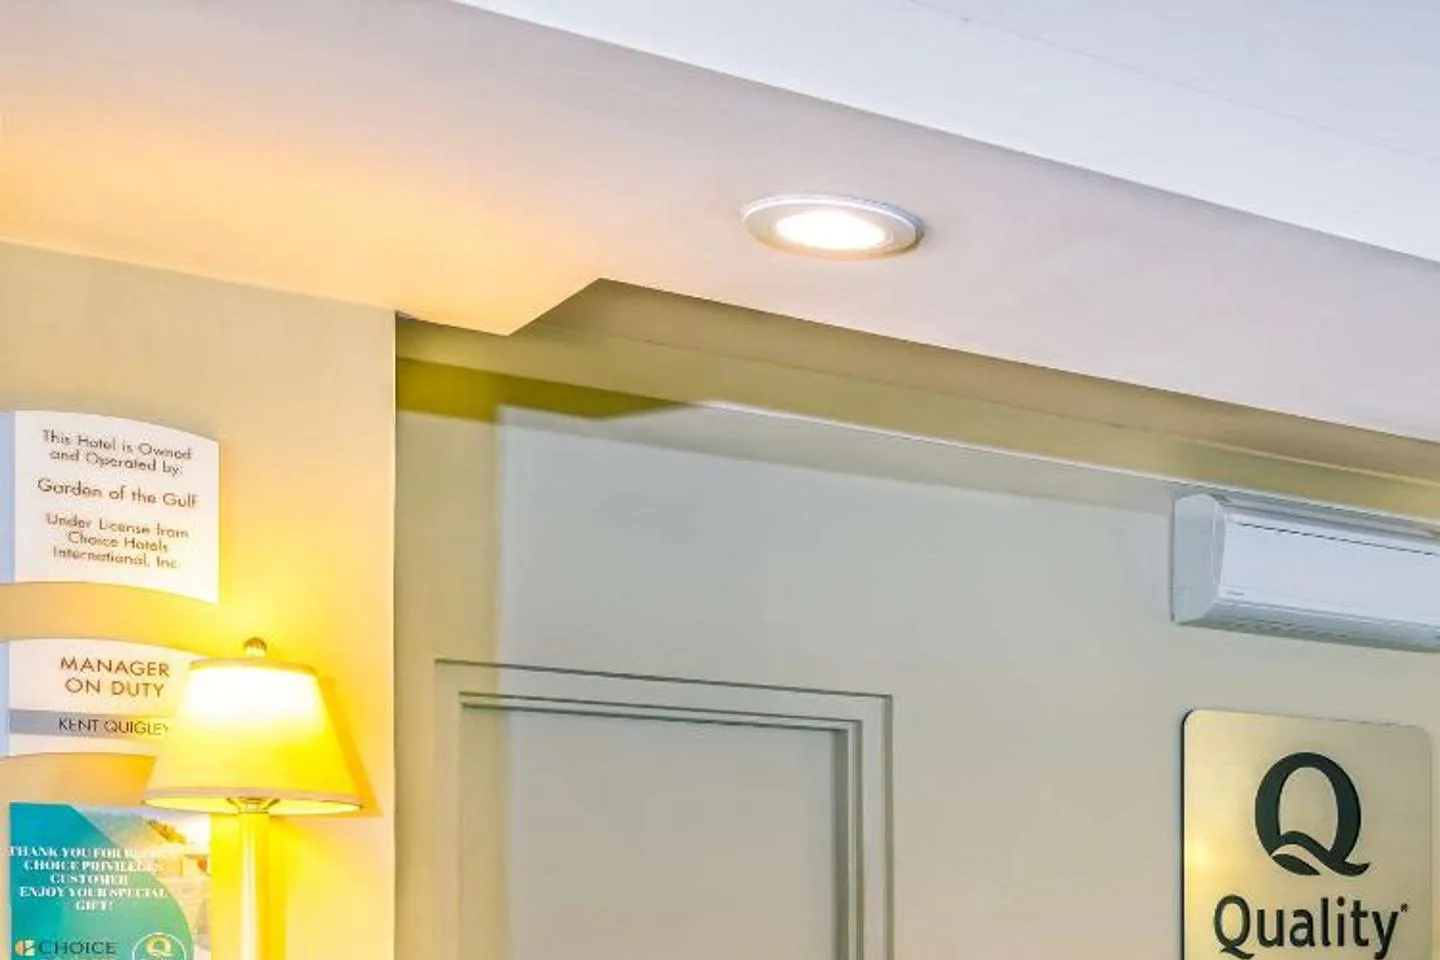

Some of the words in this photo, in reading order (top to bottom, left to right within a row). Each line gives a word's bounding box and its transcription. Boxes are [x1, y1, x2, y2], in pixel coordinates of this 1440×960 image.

[43, 429, 71, 446] This
[77, 433, 117, 452] Hotel
[121, 441, 133, 453] is
[138, 441, 193, 460] Owned
[50, 450, 80, 463] and
[86, 451, 157, 473] Operated
[37, 477, 102, 498] Garden
[108, 485, 125, 501] of
[131, 487, 157, 505] the
[162, 492, 199, 509] Gulf
[46, 512, 91, 529] Under
[99, 517, 151, 535] License
[156, 523, 189, 539] from
[66, 530, 119, 549] Choice
[124, 536, 169, 554] Hotels
[60, 656, 170, 678] MANAGER
[64, 677, 101, 695] ON
[111, 680, 165, 699] DUTY
[58, 716, 100, 734] KENT
[103, 719, 169, 737] QUIGLEY
[1254, 751, 1371, 877] Q
[10, 845, 58, 858] THANK
[61, 847, 92, 859] YOU
[93, 848, 121, 859] FOR
[24, 859, 76, 871] CHOICE
[50, 873, 128, 886] CUSTOMER
[19, 886, 64, 898] ENJOY
[68, 887, 108, 898] YOUR
[109, 887, 169, 898] SPECIAL
[1212, 894, 1400, 960] Quality
[38, 941, 117, 955] CHOICE
